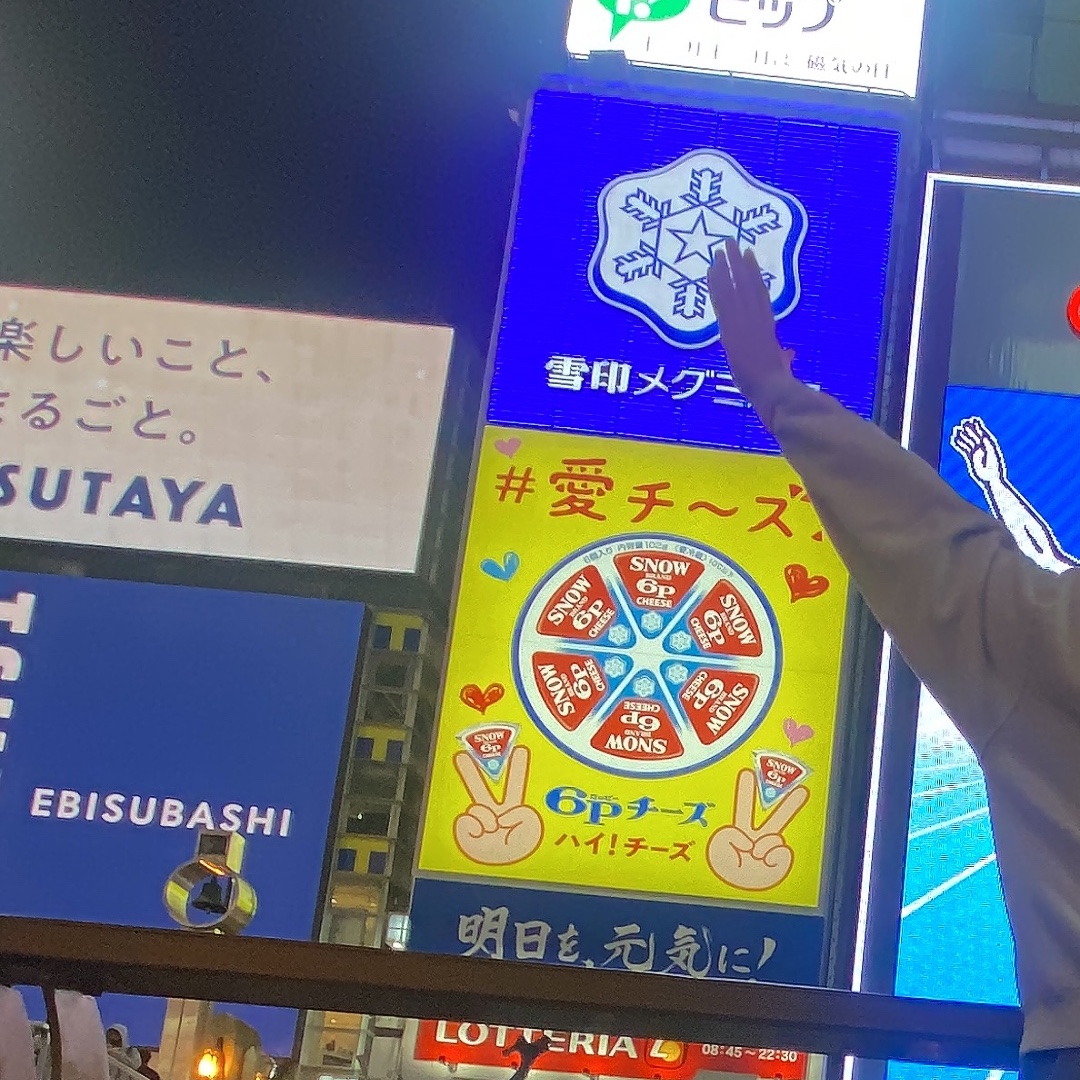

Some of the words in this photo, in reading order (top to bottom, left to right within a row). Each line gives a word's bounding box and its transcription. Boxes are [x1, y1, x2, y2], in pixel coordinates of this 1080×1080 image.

[545, 355, 820, 409] 雪印メグミ
[629, 556, 691, 576] SNOW
[547, 573, 592, 626] SNOW
[636, 596, 673, 608] CHEESE
[588, 608, 615, 638] CHEESE
[690, 617, 712, 650] CHEESE
[719, 593, 757, 645] SNOW
[537, 664, 576, 717] SNOW
[584, 658, 606, 691] CHEESE
[681, 671, 708, 702] CHEESE
[623, 701, 661, 713] CHEESE
[706, 682, 750, 736] SNOW
[473, 730, 505, 743] SNOW
[604, 733, 668, 755] SNOW
[766, 758, 797, 775] SNOW
[30, 787, 292, 837] EBISUBASHI
[435, 1019, 638, 1059] LOTTERIA
